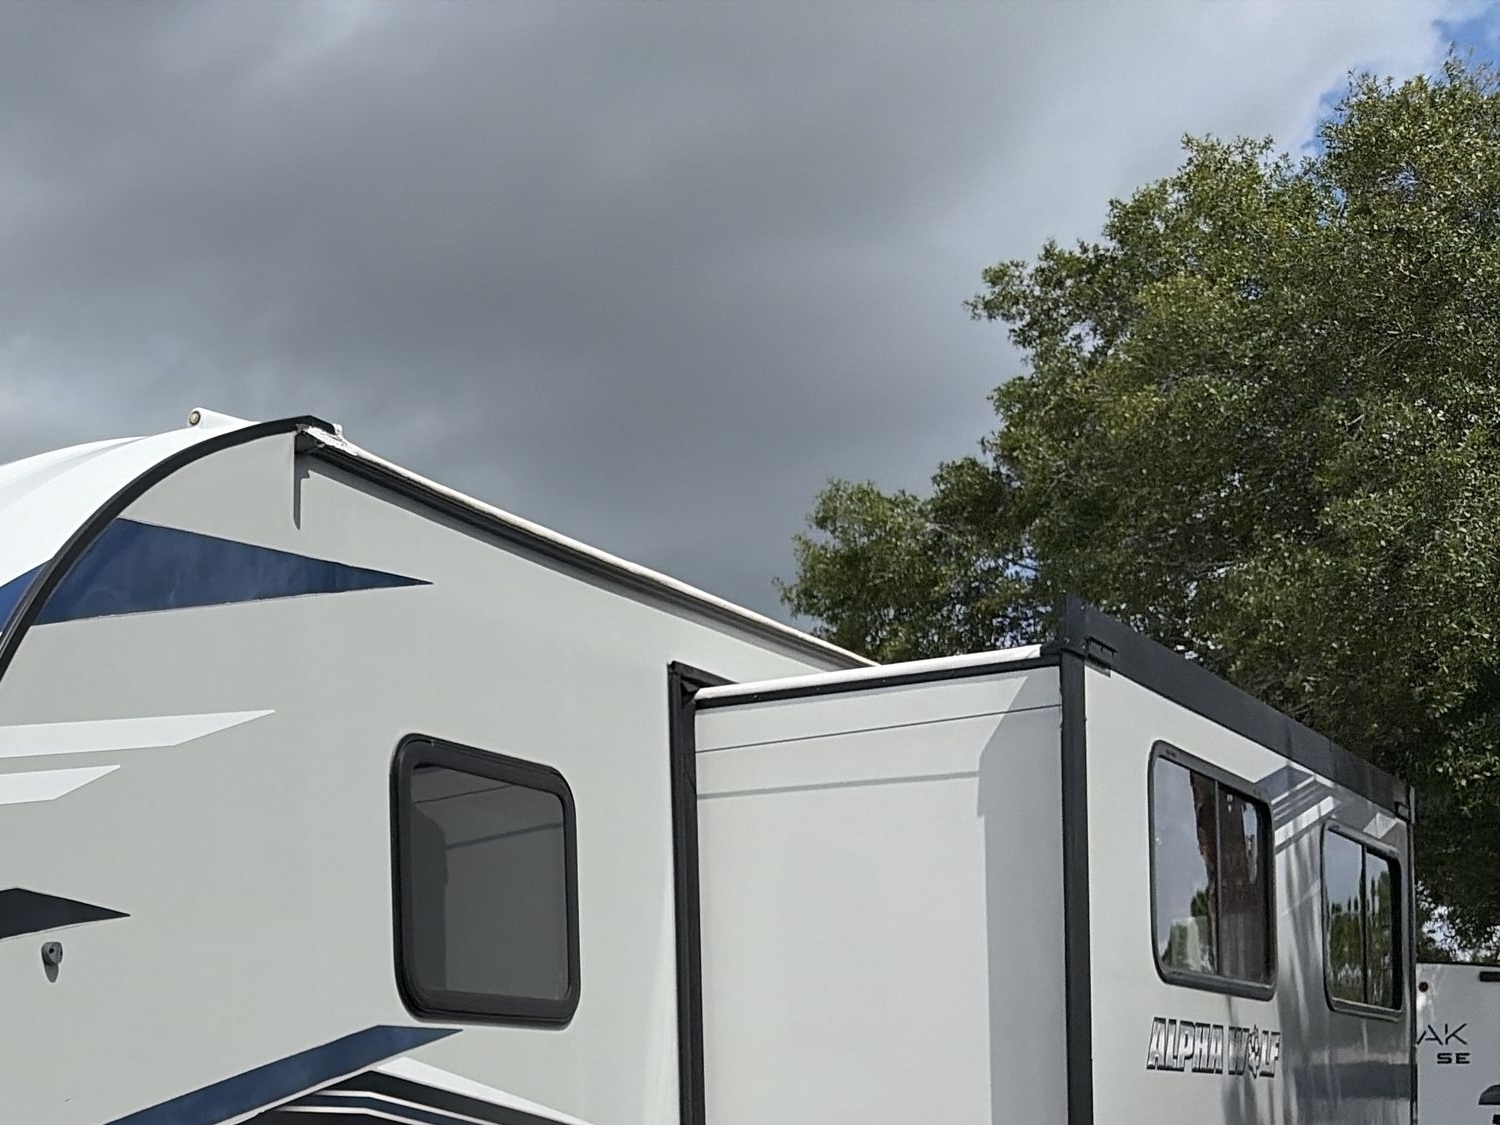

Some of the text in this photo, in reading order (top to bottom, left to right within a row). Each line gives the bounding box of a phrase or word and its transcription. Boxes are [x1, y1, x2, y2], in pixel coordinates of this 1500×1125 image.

[1146, 1016, 1281, 1079] ALPHA WOLF
[1436, 1052, 1471, 1065] SE
